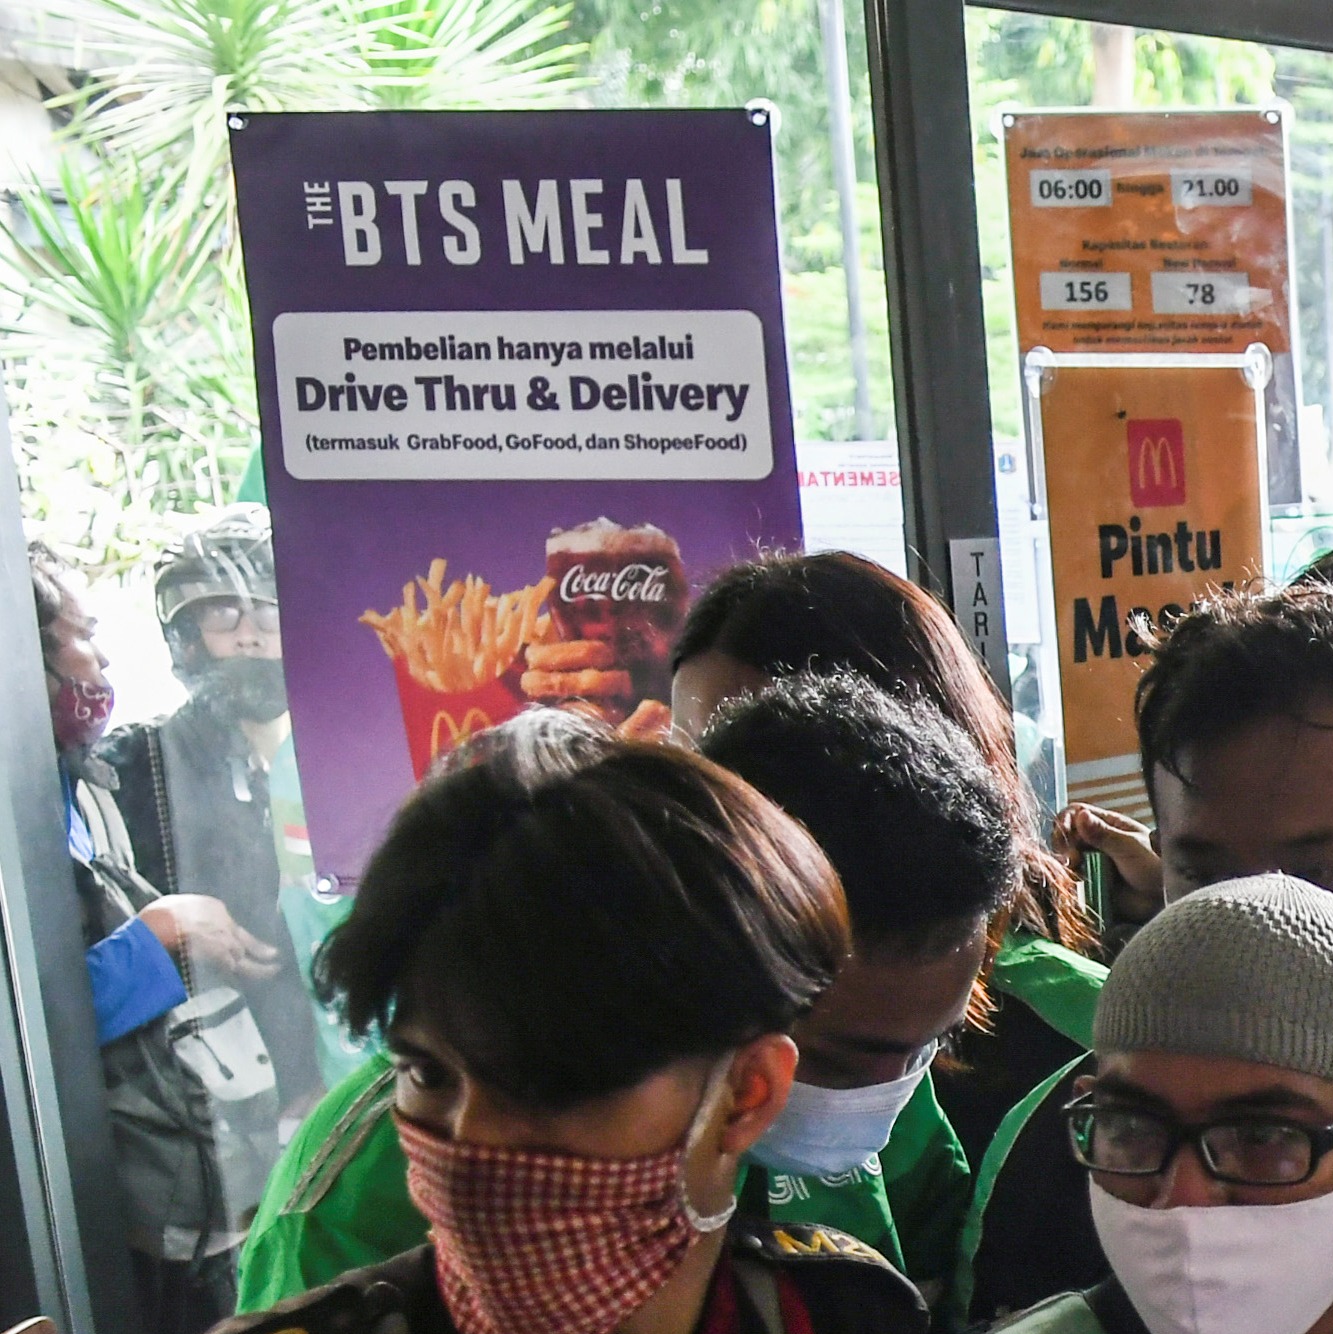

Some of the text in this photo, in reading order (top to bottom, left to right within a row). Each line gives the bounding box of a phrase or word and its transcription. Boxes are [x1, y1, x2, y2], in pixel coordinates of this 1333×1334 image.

[303, 181, 334, 229] THE
[1039, 179, 1102, 200] 06:00
[337, 178, 709, 266] BTS MEAL
[1065, 281, 1109, 303] 156
[1186, 283, 1216, 304] 78
[343, 334, 694, 367] Pembelian hanya melalui
[295, 372, 750, 421] Drive Thru & Delivery
[305, 432, 748, 455] (termasuk GrabFood, GoFood, dan ShopeeFood)
[1099, 516, 1221, 579] Pintu
[560, 563, 671, 603] Coca-Cola
